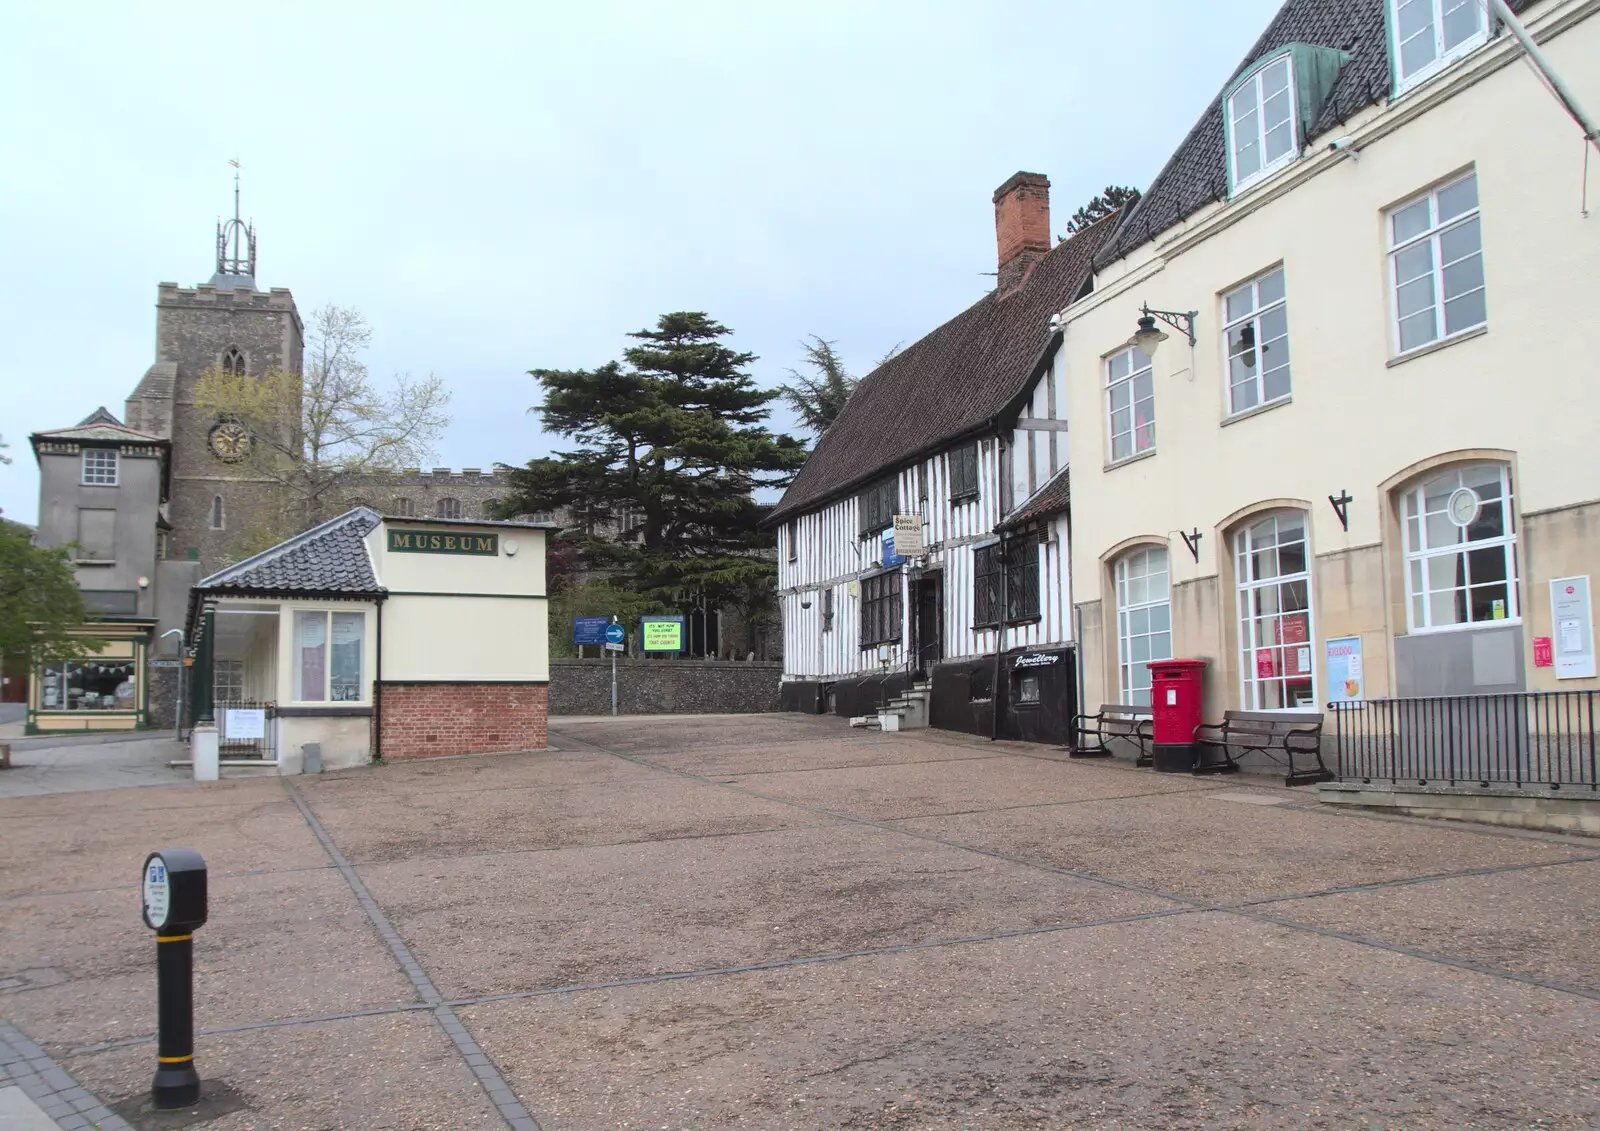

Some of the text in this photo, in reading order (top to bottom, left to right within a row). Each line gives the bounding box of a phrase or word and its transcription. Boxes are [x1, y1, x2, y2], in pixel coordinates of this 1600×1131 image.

[895, 517, 913, 525] Spice
[895, 524, 920, 532] Cottage
[393, 533, 493, 551] MUSEUM
[1015, 654, 1059, 667] Jewellery
